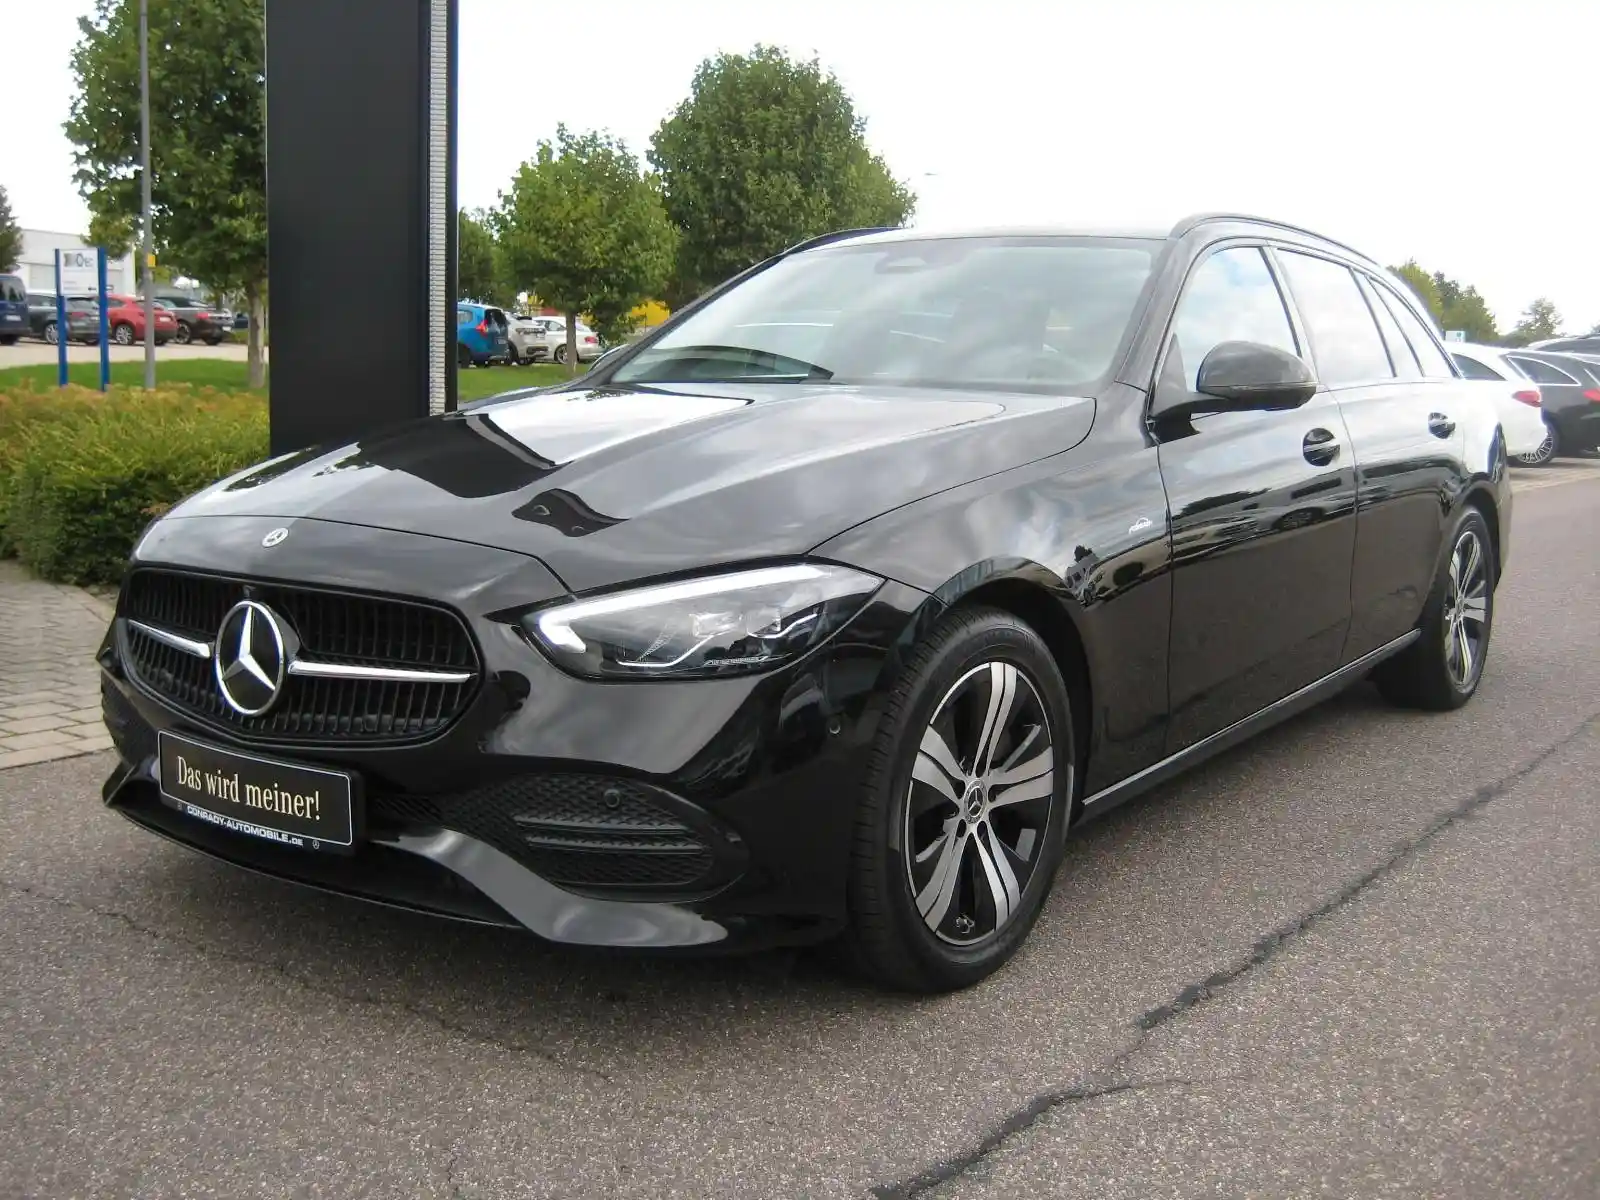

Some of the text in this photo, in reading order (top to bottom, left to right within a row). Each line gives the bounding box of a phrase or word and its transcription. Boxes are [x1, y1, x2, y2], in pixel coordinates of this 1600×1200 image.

[177, 755, 320, 820] Das wird meiner!
